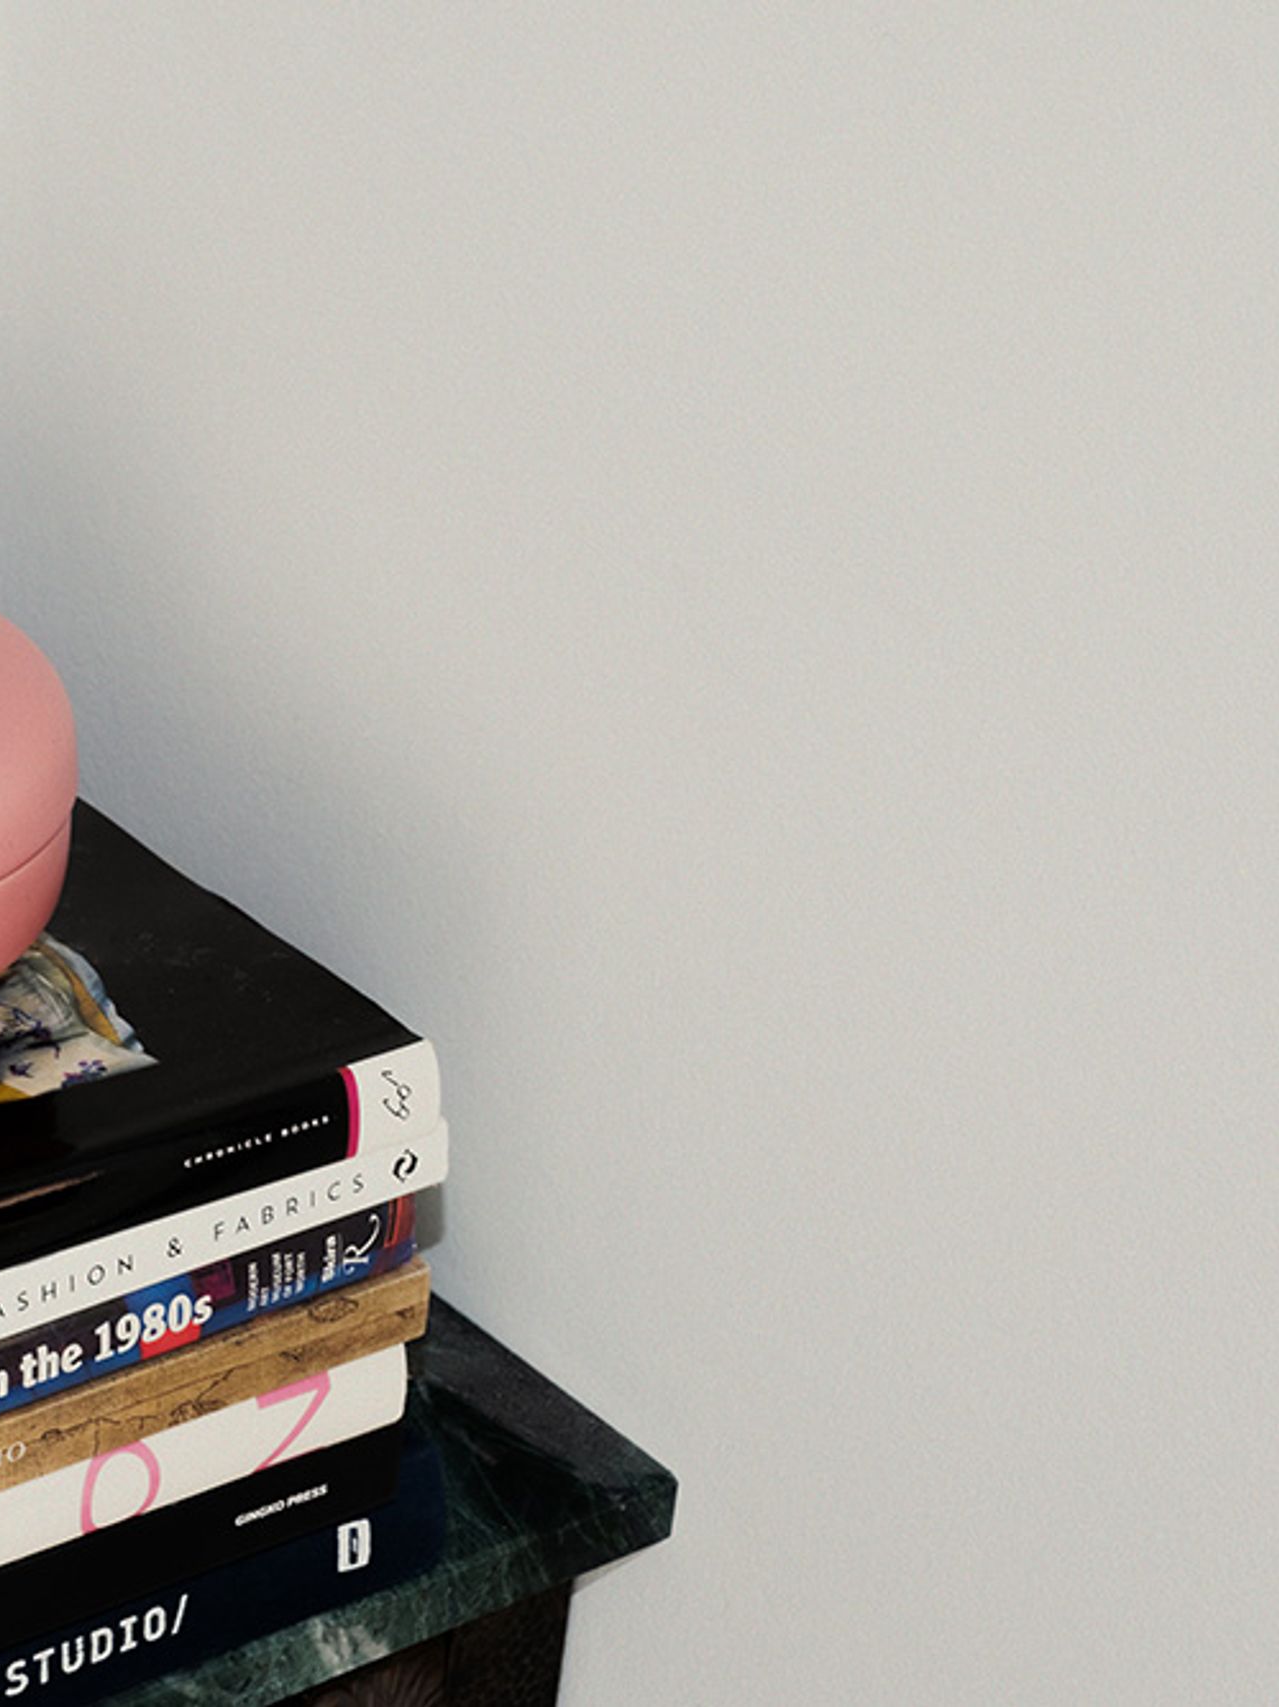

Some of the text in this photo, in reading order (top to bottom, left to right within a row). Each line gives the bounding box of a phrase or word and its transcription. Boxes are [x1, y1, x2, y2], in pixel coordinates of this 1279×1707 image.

[183, 1114, 330, 1169] CHRONICLE BOOKS
[166, 1236, 183, 1259] &
[213, 1173, 366, 1241] FABRICS
[19, 1343, 83, 1390] the
[93, 1292, 215, 1363] 1980s
[285, 1482, 330, 1509] PRESS
